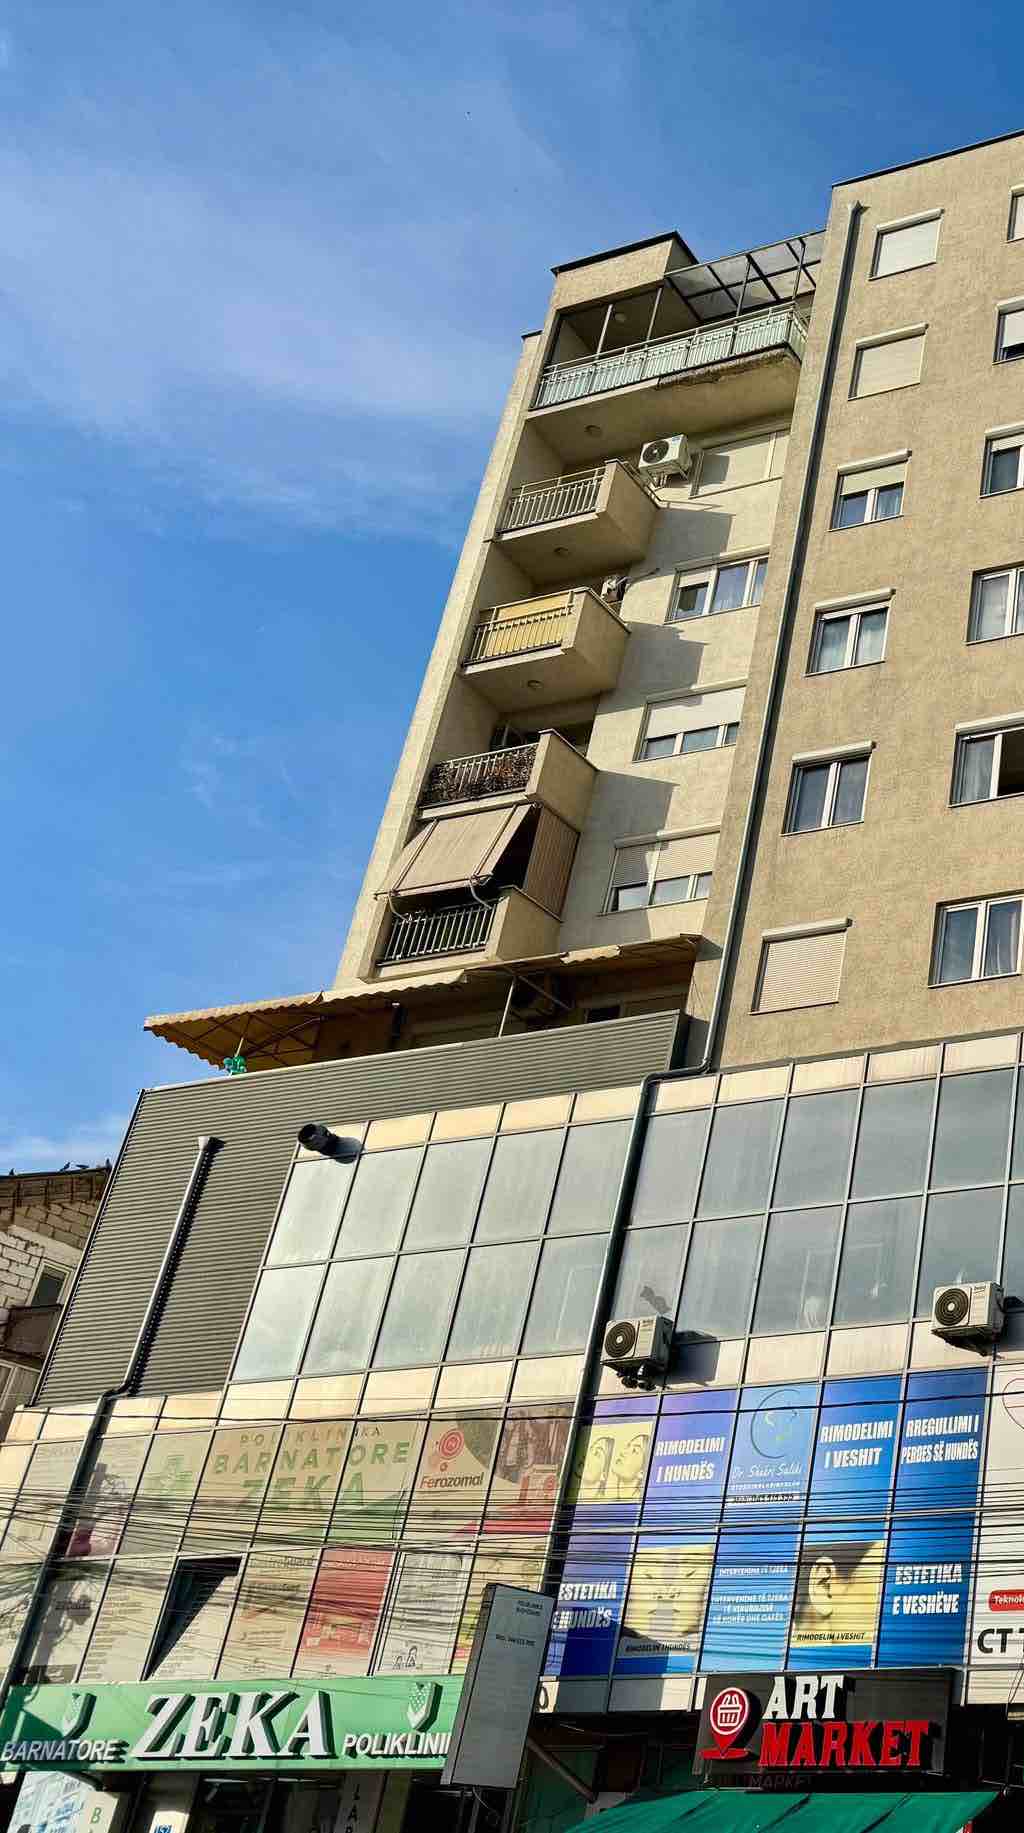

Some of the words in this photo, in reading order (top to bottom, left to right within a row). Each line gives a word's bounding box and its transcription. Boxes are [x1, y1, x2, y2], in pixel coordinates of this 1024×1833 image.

[820, 1420, 894, 1443] RIMODELIMI
[905, 1416, 971, 1438] RREGULLIMI
[974, 1414, 980, 1433] I
[214, 1441, 411, 1474] BARNATORE
[656, 1437, 726, 1456] RIMODELIMI
[833, 1447, 883, 1468] VESHIT
[944, 1440, 979, 1462] HUNDËS
[664, 1460, 715, 1482] HUNDËS
[236, 1471, 364, 1512] ZEKA
[894, 1563, 963, 1585] ESTETIKA
[558, 1581, 618, 1600] ESTETIKA
[891, 1596, 900, 1615] E
[901, 1591, 960, 1614] VESHËVE
[560, 1605, 613, 1629] HUNDËS
[977, 1628, 1013, 1654] CT
[761, 1674, 845, 1720] ART
[131, 1689, 334, 1759] ZEKA
[1, 1740, 116, 1762] BARNATORE
[757, 1719, 929, 1768] MARKET
